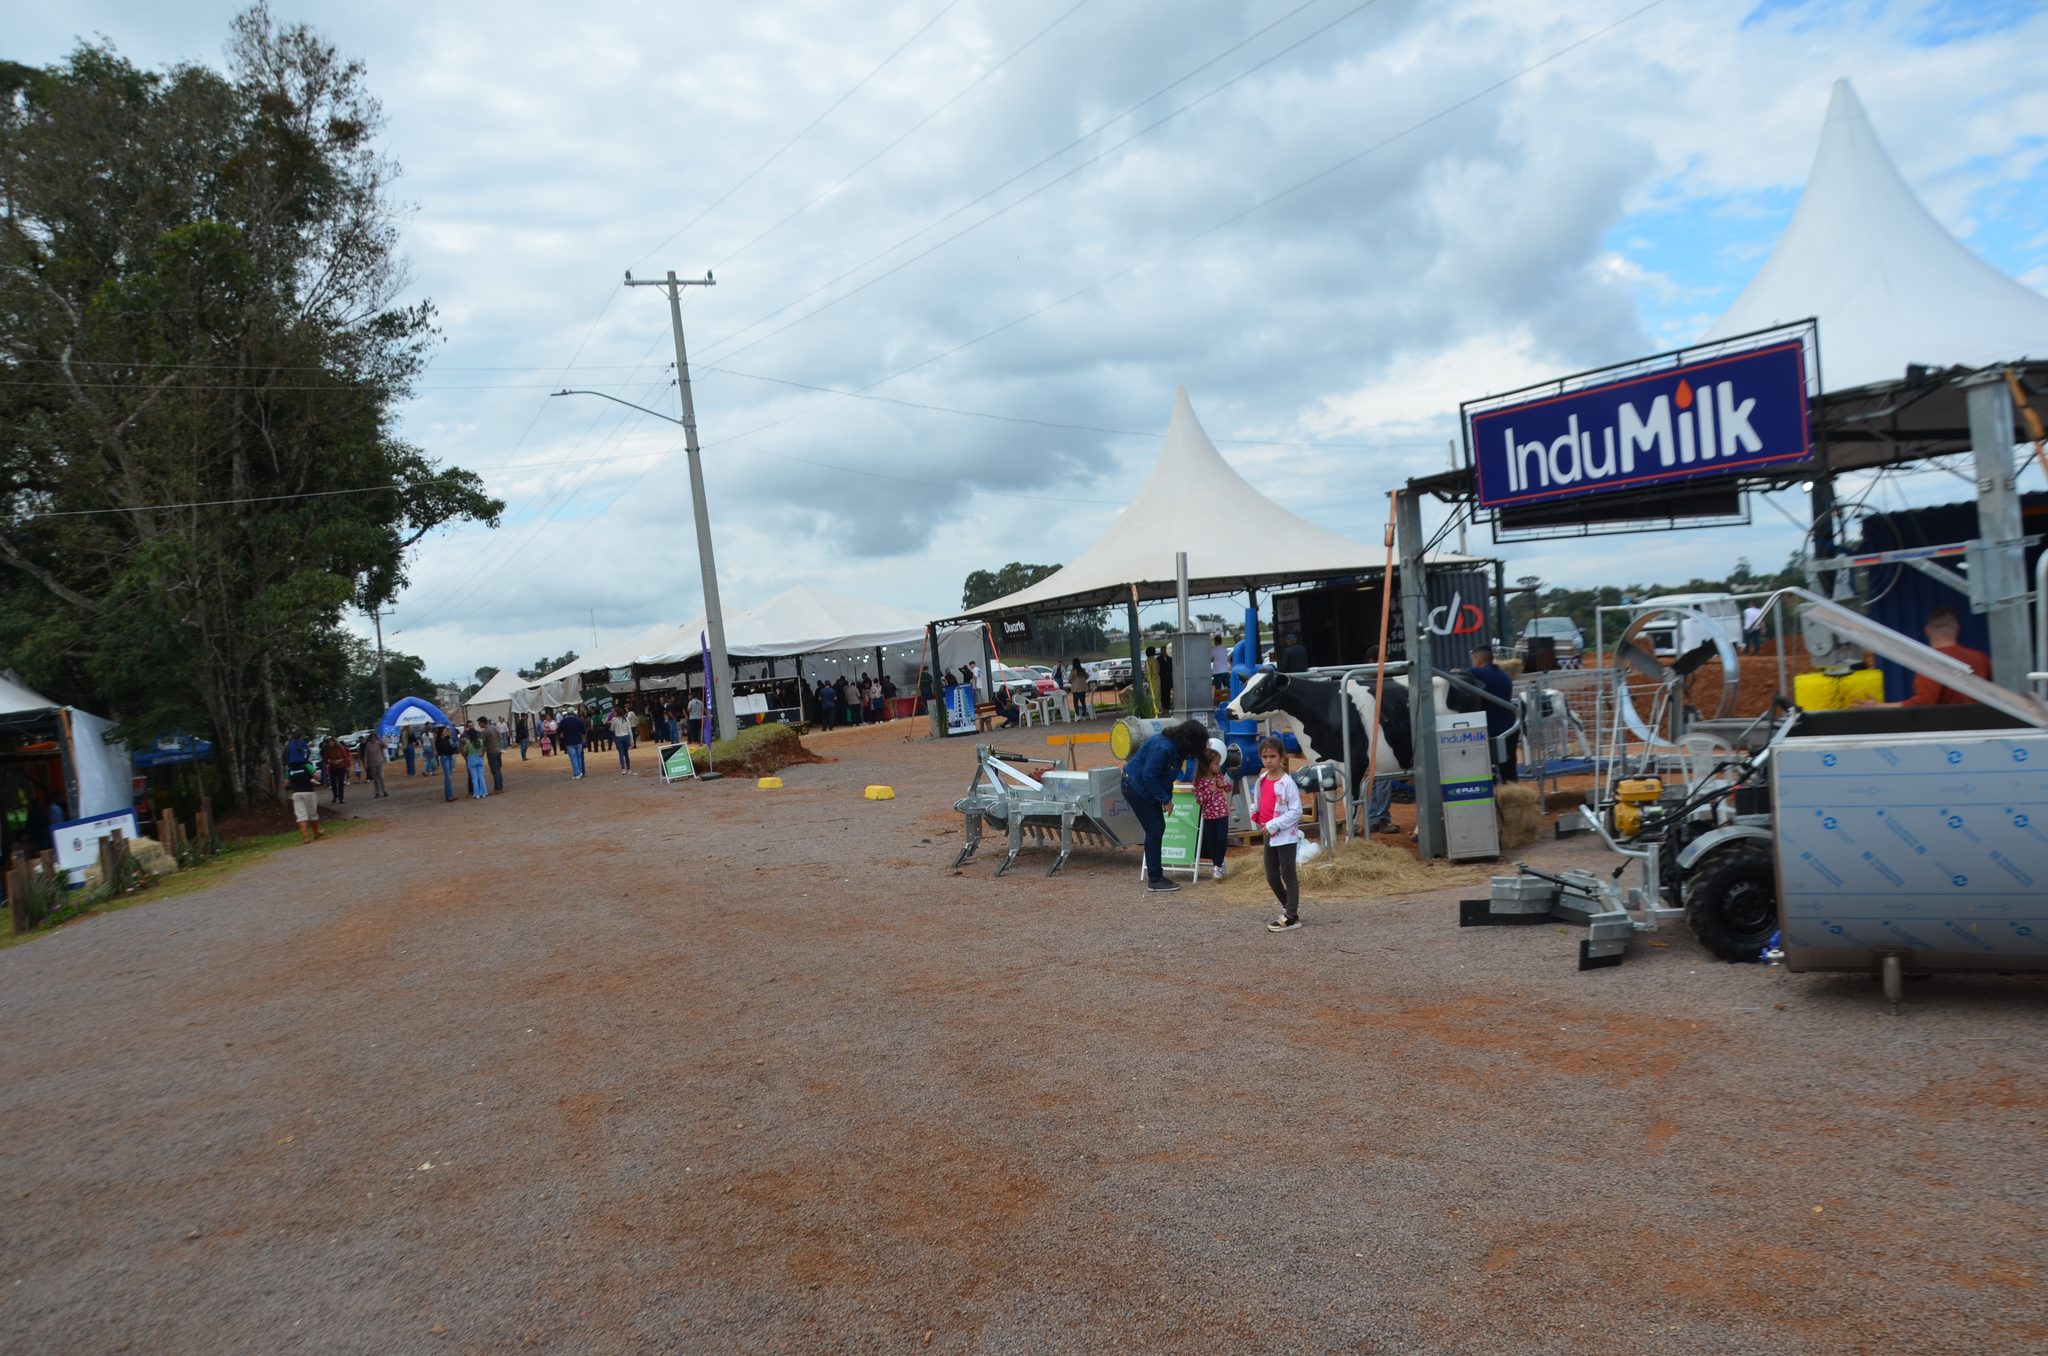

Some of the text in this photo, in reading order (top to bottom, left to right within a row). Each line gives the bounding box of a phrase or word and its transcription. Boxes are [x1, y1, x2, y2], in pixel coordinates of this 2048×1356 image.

[1504, 380, 1763, 492] InduMilk
[1003, 620, 1026, 633] Duarte
[1440, 731, 1486, 745] InduMilk
